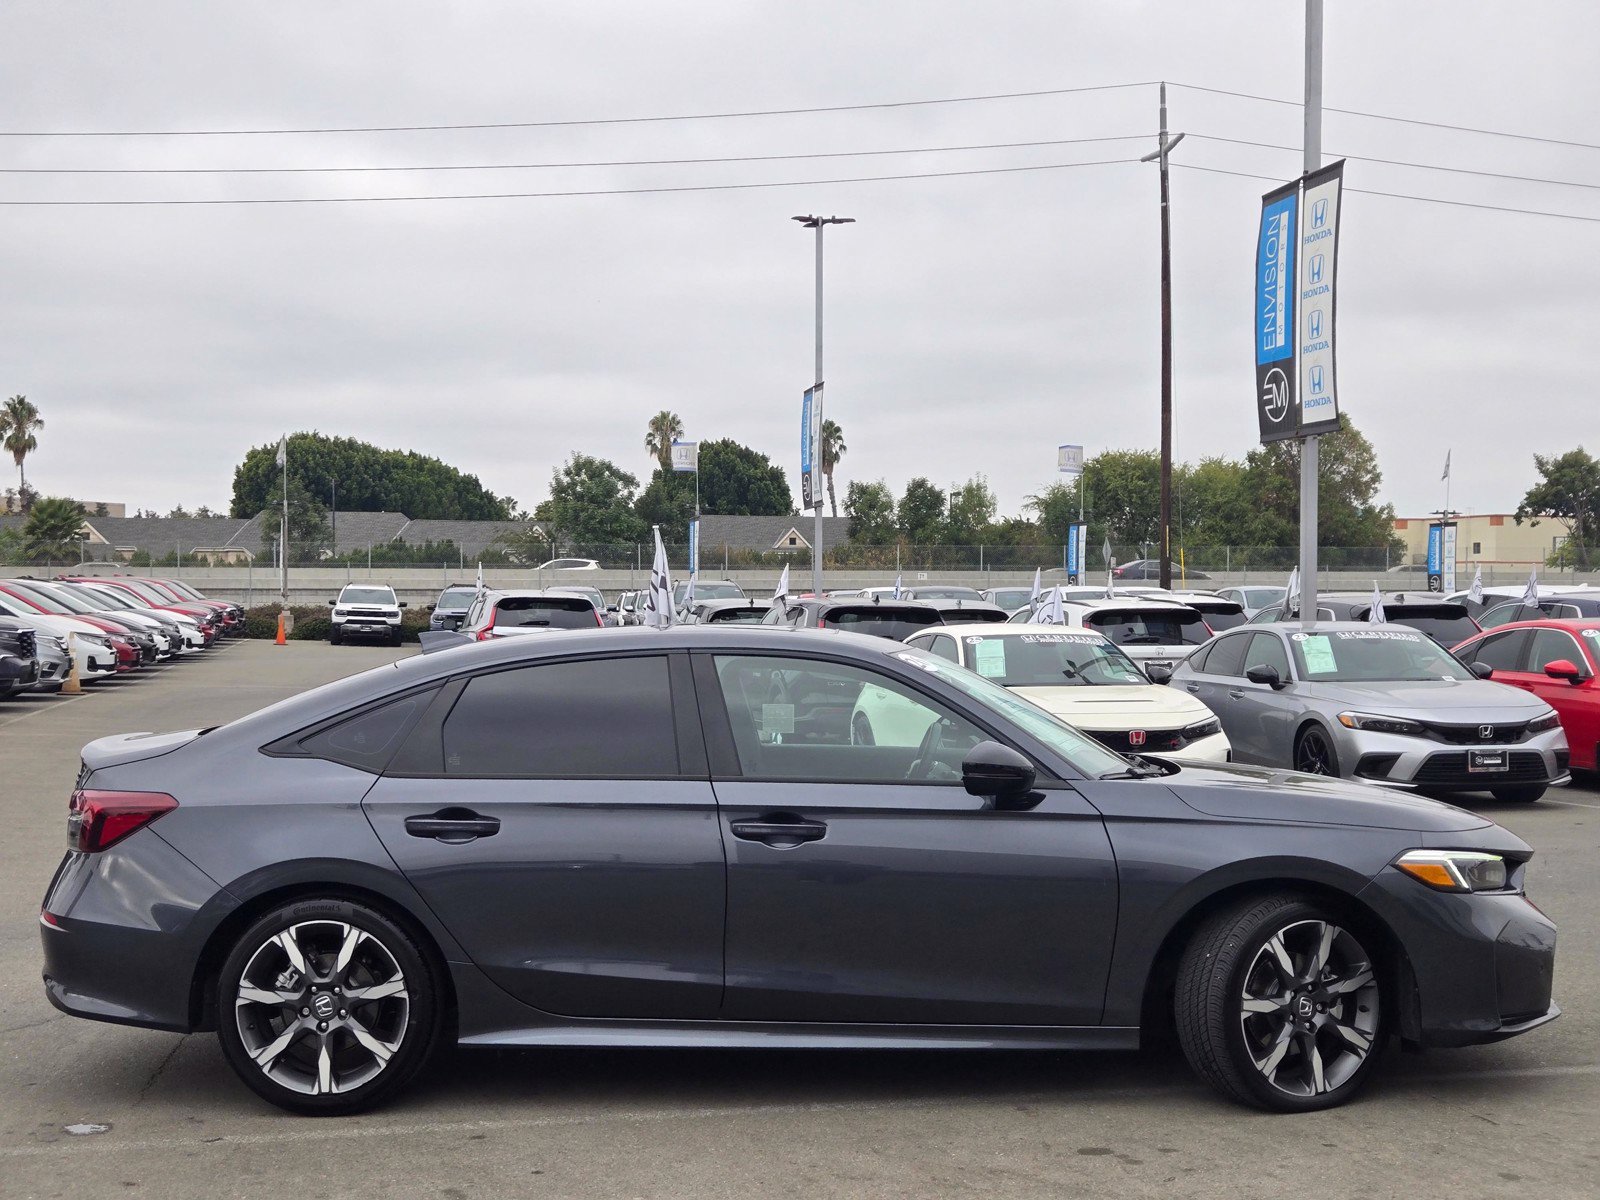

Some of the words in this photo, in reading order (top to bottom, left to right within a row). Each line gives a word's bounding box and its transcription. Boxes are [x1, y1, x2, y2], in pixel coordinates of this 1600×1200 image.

[1304, 228, 1333, 244] HONDA
[1263, 214, 1280, 350] ENVISION
[1278, 224, 1287, 335] MOTORS
[1303, 284, 1330, 299] HONDA
[1303, 340, 1329, 353] HONDA
[1304, 396, 1332, 408] HONDA
